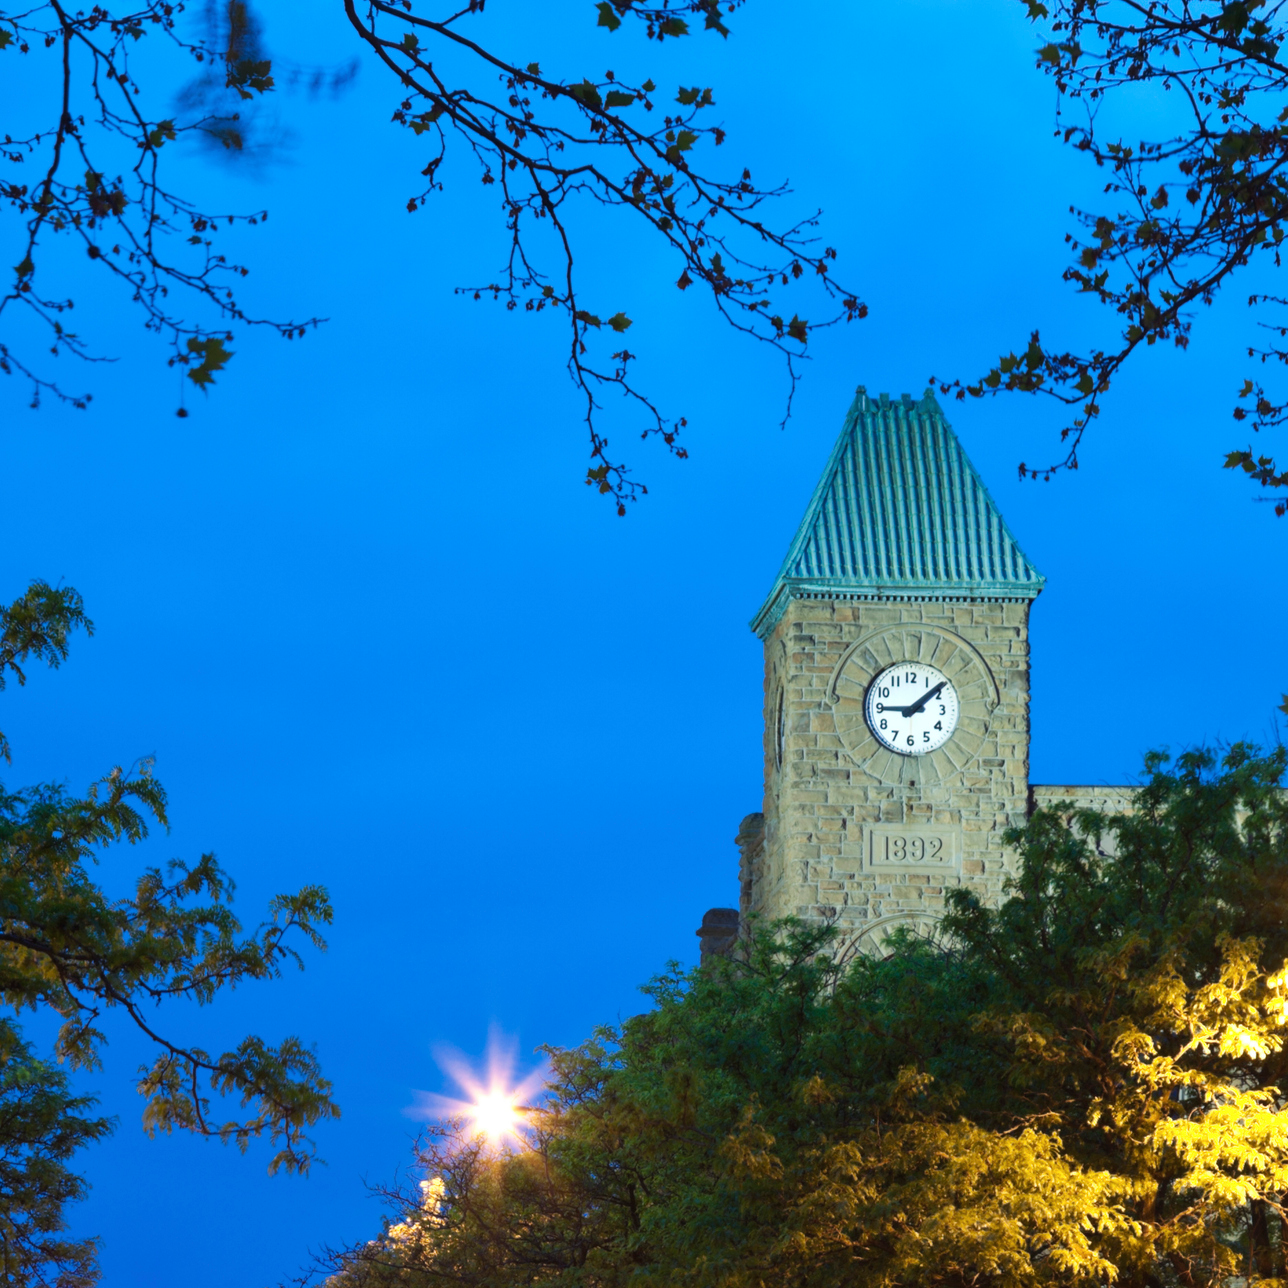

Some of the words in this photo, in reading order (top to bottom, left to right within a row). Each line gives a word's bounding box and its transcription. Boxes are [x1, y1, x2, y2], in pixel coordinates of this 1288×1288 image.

[891, 675, 900, 687] 11
[905, 672, 917, 684] 12
[925, 676, 929, 688] 1
[878, 686, 890, 698] 10
[875, 702, 884, 714] 9
[939, 704, 946, 716] 3
[879, 718, 888, 730] 8
[933, 720, 943, 731] 4
[891, 730, 899, 742] 7
[906, 735, 915, 746] 6
[923, 731, 930, 742] 5
[882, 836, 943, 862] 1892
